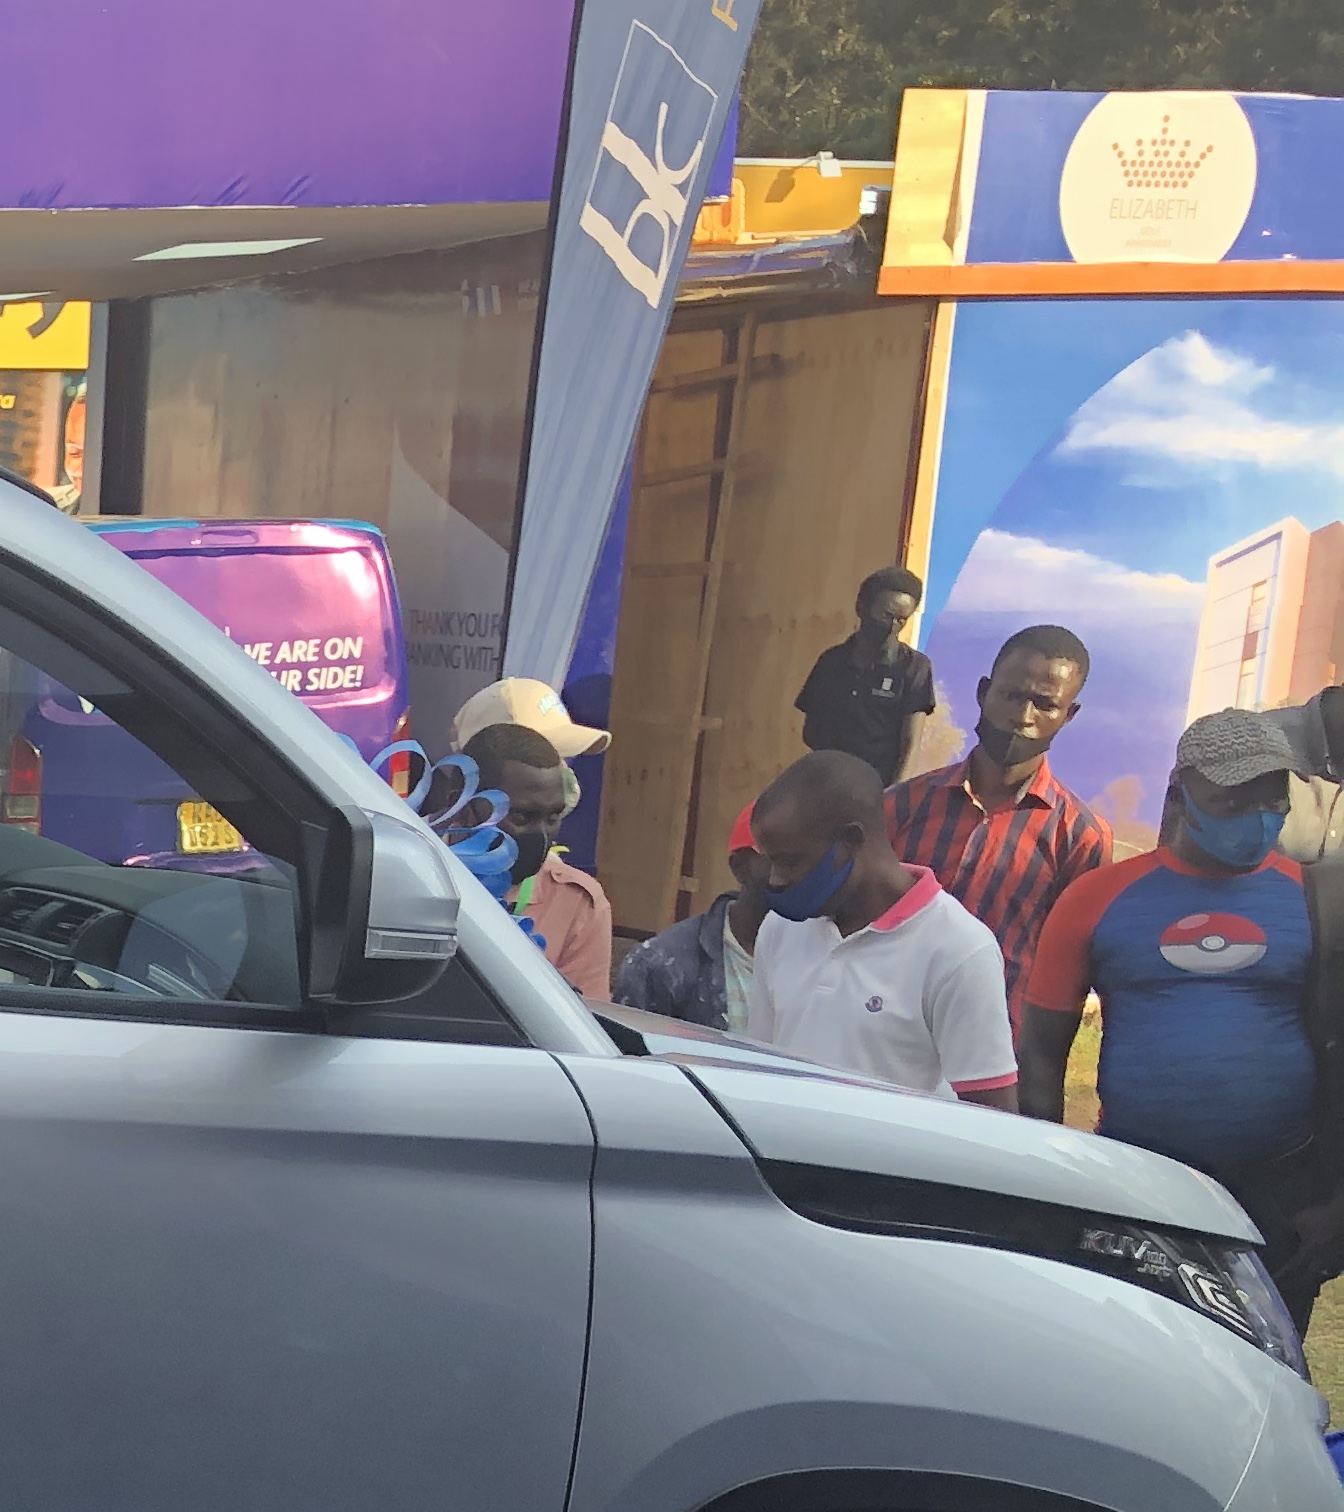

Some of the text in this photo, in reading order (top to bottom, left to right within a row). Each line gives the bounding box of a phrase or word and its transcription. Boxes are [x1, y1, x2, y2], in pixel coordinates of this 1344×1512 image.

[1108, 198, 1199, 220] ELIZABETH
[274, 638, 321, 664] ARE
[324, 636, 364, 661] ON
[305, 665, 365, 691] SIDE!
